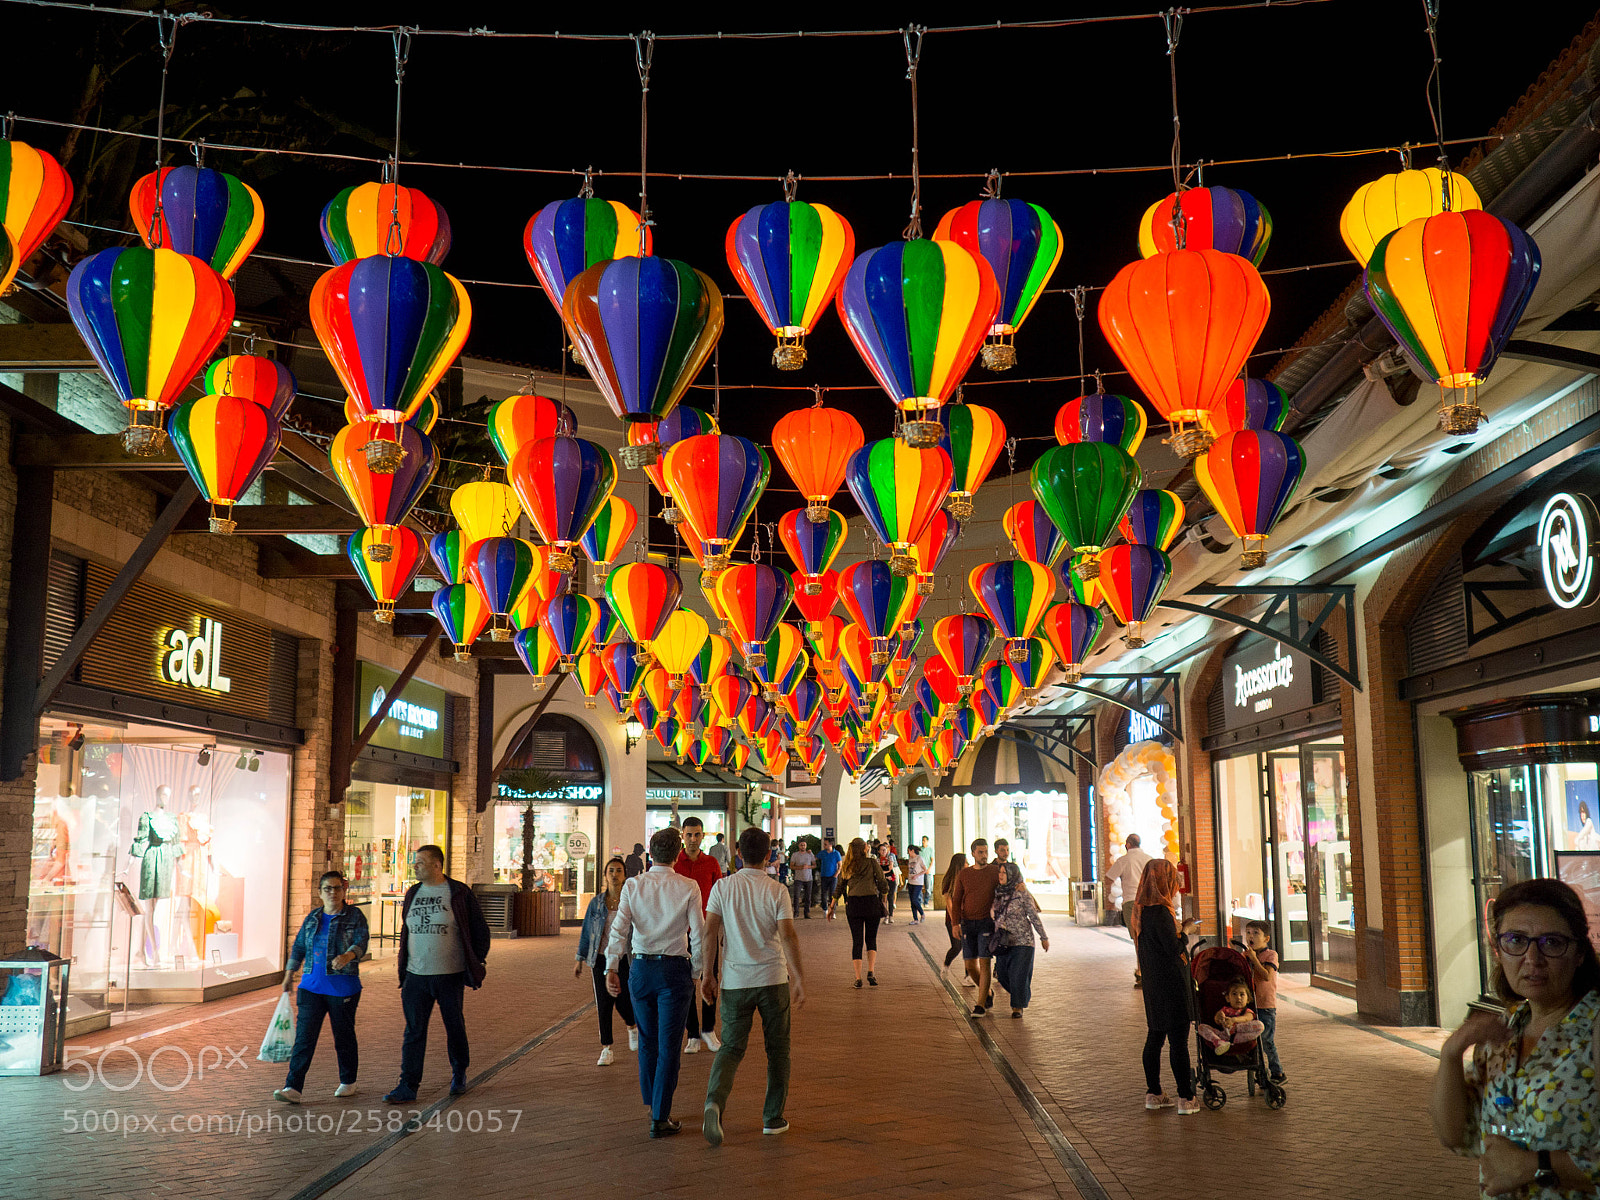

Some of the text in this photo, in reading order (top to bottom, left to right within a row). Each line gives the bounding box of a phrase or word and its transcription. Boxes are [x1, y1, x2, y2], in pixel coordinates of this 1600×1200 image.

[166, 617, 231, 693] adL
[1235, 641, 1294, 707] Accessorize
[565, 786, 603, 800] SHOP
[569, 839, 582, 848] 50
[414, 896, 442, 906] BEING
[420, 915, 431, 925] IS
